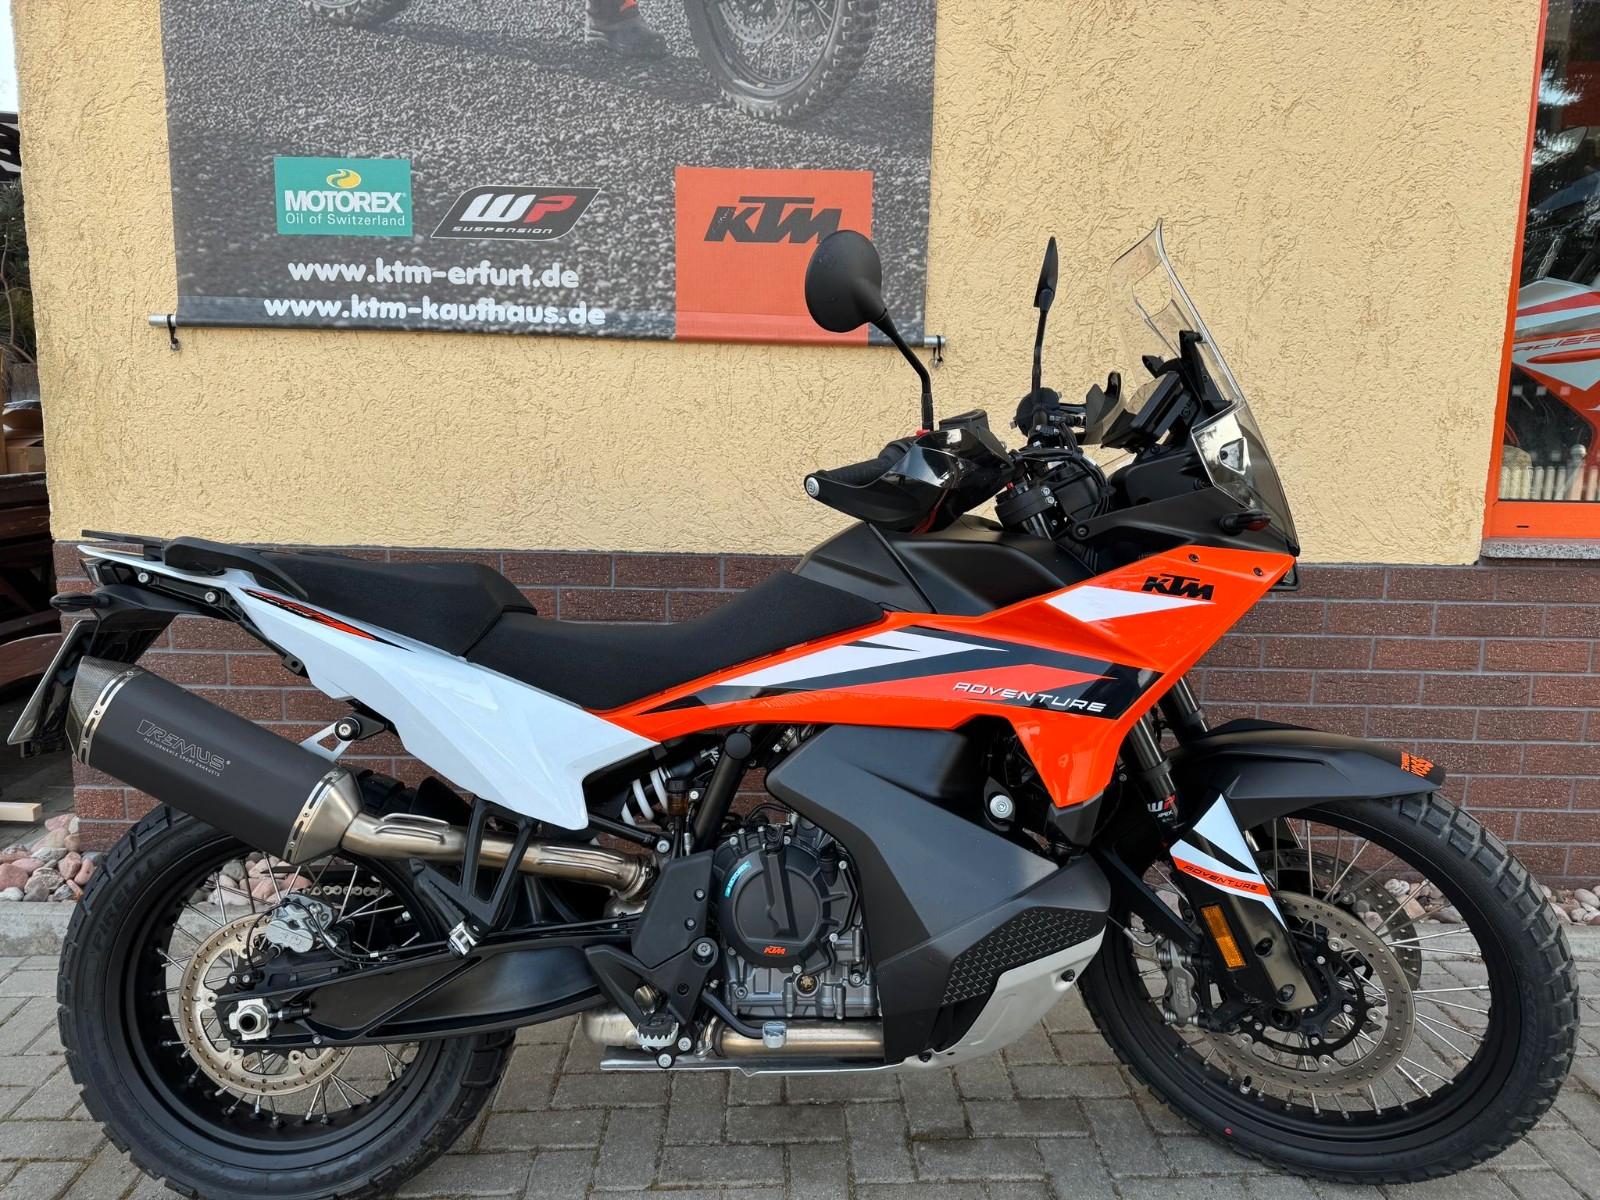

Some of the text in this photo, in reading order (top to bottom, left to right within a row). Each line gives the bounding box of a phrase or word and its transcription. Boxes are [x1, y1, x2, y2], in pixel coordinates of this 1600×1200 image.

[284, 190, 404, 213] MOTOREX
[459, 193, 577, 223] WP
[285, 213, 405, 226] Oil of Switzerland
[452, 226, 552, 234] SUSPENSION
[703, 196, 842, 244] KTM
[288, 257, 580, 288] www.ktm-erfurt.de
[264, 294, 606, 325] www.ktm-kaufhaus.de
[1141, 573, 1215, 600] KTM
[952, 682, 1107, 713] ADVENTURE
[146, 726, 225, 771] REMUS
[1183, 865, 1259, 891] ADVENTURE
[763, 945, 786, 955] KTM
